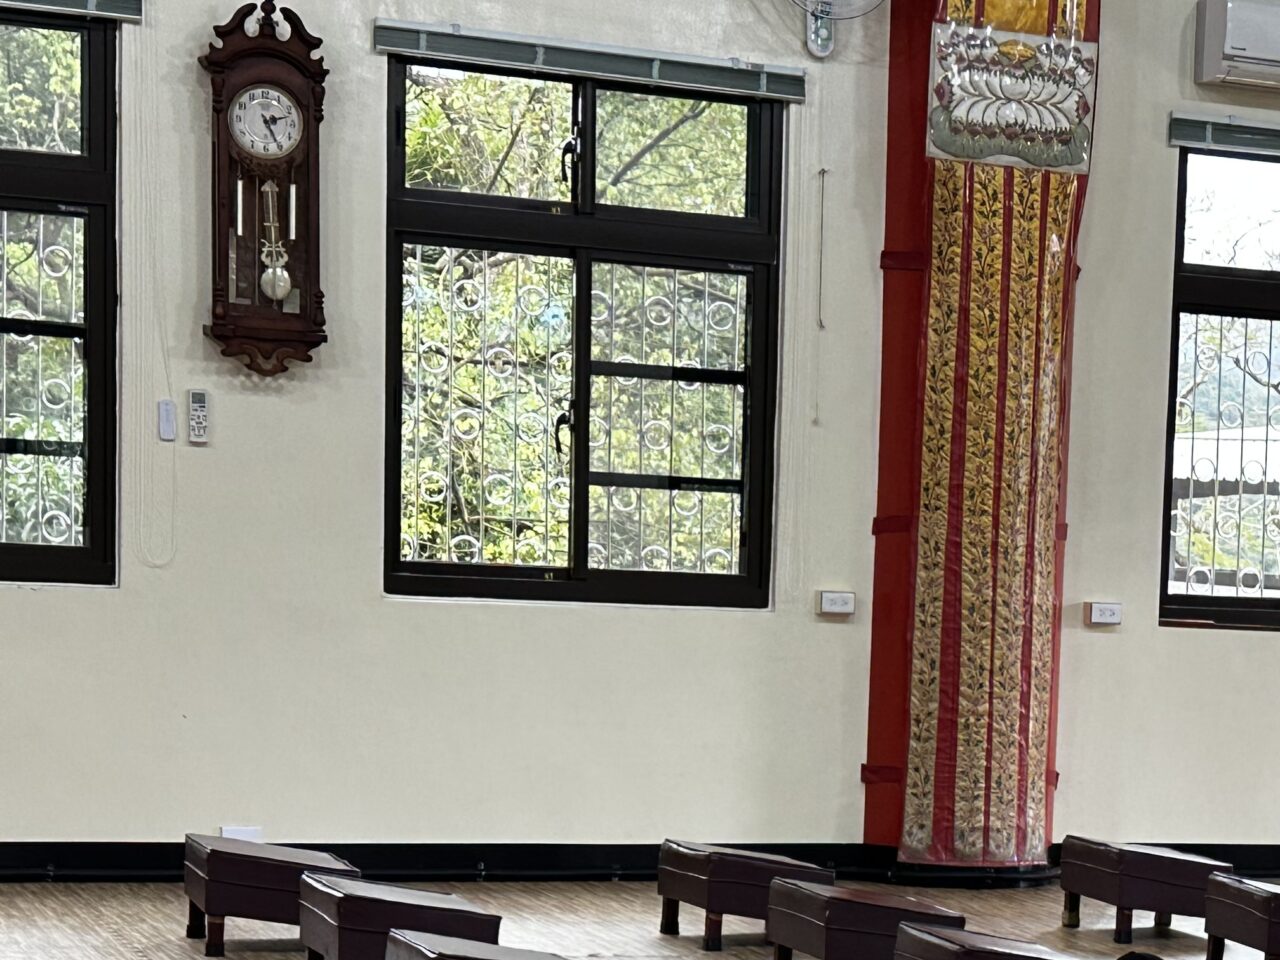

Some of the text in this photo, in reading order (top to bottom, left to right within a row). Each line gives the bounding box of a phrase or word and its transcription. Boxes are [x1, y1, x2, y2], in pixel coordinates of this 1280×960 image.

[261, 90, 270, 99] 12
[276, 95, 281, 103] 1
[285, 105, 292, 114] 2
[250, 140, 255, 149] 7
[263, 144, 270, 152] 6
